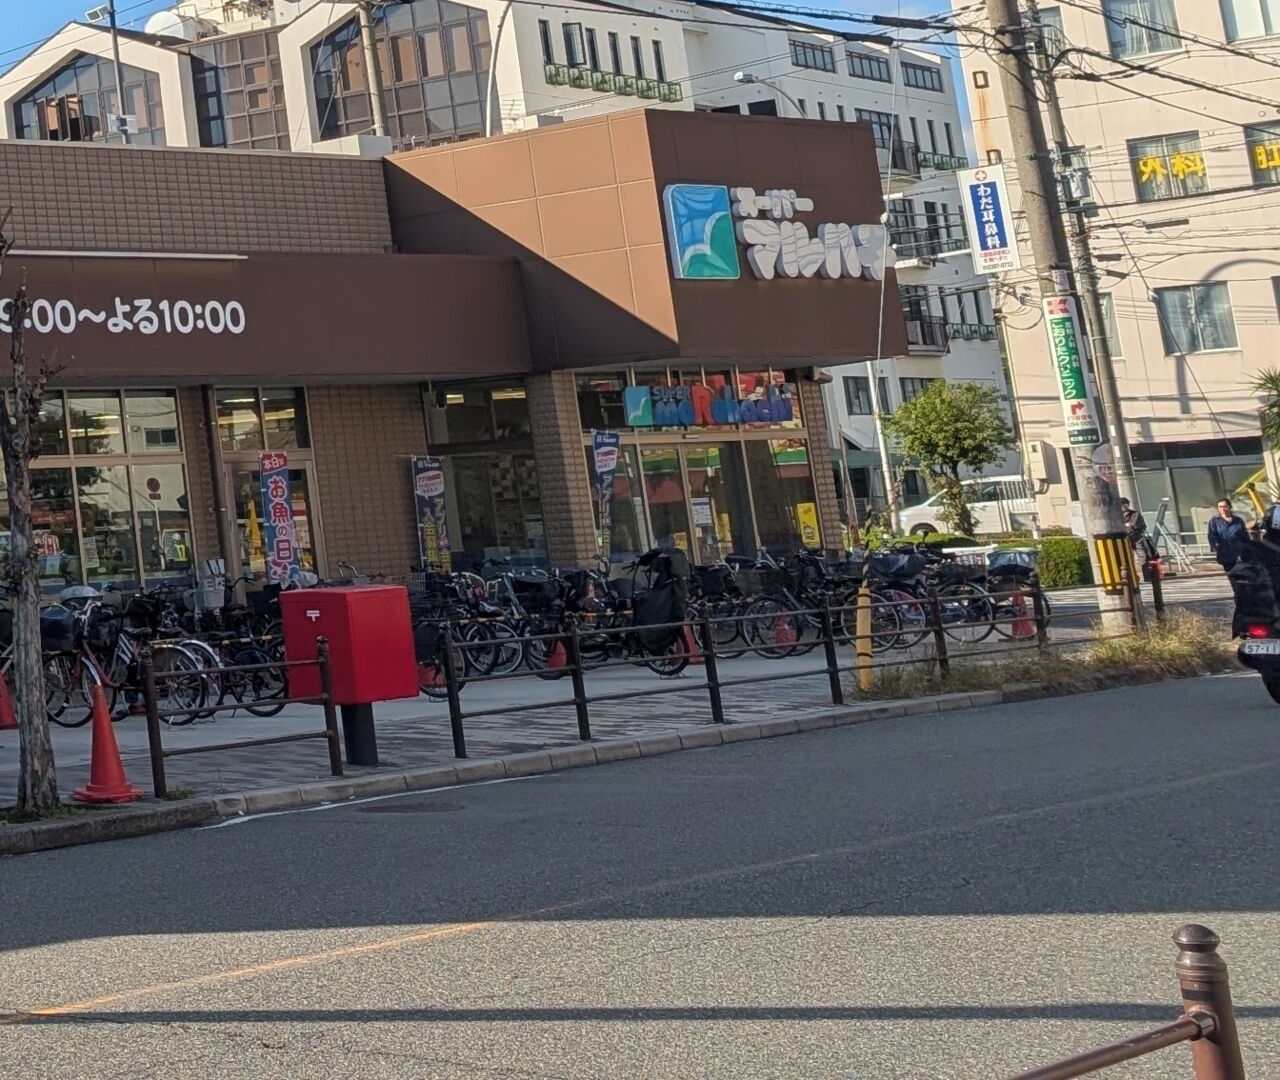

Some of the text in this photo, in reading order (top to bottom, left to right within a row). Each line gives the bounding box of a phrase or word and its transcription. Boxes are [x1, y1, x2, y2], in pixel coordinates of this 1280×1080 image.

[1138, 152, 1205, 185] 外科
[730, 187, 814, 219] スーパー
[976, 184, 1000, 249] わだ耳鼻科
[736, 219, 897, 281] マルハチ
[268, 476, 293, 562] お魚の日
